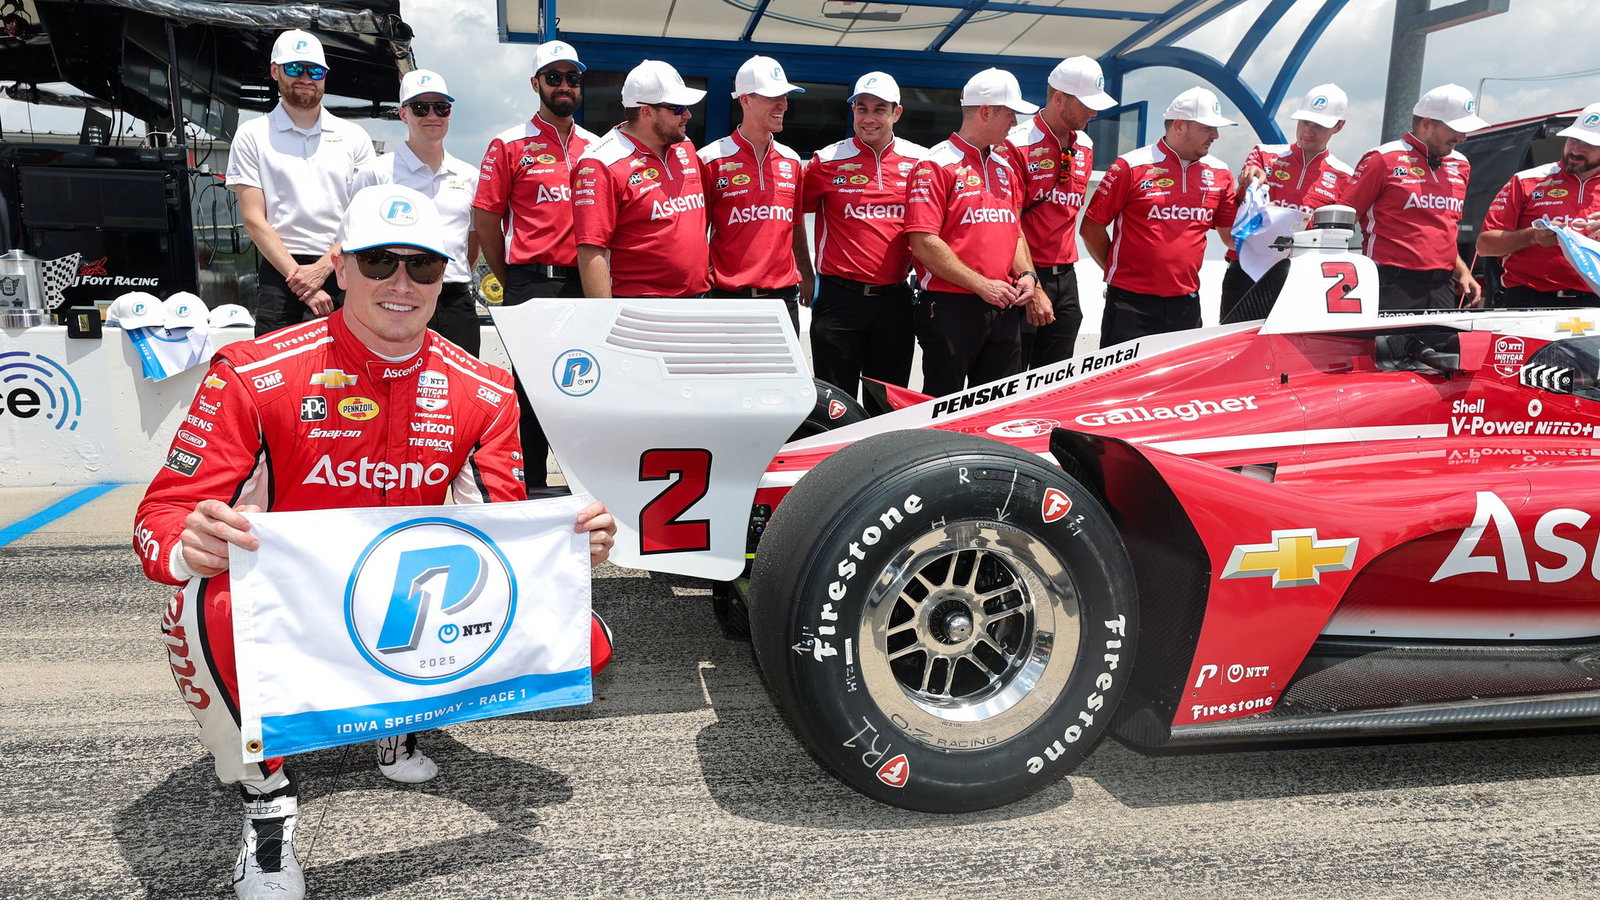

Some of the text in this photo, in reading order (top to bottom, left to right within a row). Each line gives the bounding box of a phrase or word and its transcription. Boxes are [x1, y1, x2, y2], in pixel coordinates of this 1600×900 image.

[536, 184, 572, 204] Ast
[728, 204, 793, 226] Astemo
[844, 202, 905, 220] Astem
[960, 207, 1016, 224] Astem
[1147, 204, 1214, 221] Astemo
[82, 275, 113, 285] FOYT
[114, 276, 159, 286] RACING
[1321, 262, 1362, 313] 2
[1494, 353, 1524, 361] INDYCAR
[254, 372, 283, 389] OMP
[931, 342, 1140, 419] PENSKE Truck Rental
[416, 387, 449, 395] NDYCAR
[477, 388, 501, 404] OMP
[301, 399, 325, 419] PPG
[343, 402, 374, 413] PENNZOIL
[1074, 395, 1258, 427] Gallagher
[1452, 399, 1485, 413] Shell
[307, 428, 362, 439] Snap-on
[410, 420, 455, 436] verizon
[1451, 416, 1534, 435] V-Power
[425, 438, 453, 453] RACK
[302, 454, 450, 490] Astemo
[638, 448, 712, 555] 2
[1429, 491, 1600, 584] As
[813, 494, 923, 662] Firestone
[463, 622, 492, 637] NTT
[420, 656, 456, 669] 2025
[1245, 666, 1270, 678] NTT
[1026, 614, 1126, 774] Firestone
[337, 720, 378, 734] IOWA
[385, 702, 463, 729] SPEEDWAY
[479, 690, 515, 706] RACE
[520, 689, 527, 698] 1
[1191, 696, 1273, 720] Firestone
[936, 735, 998, 748] RACING
